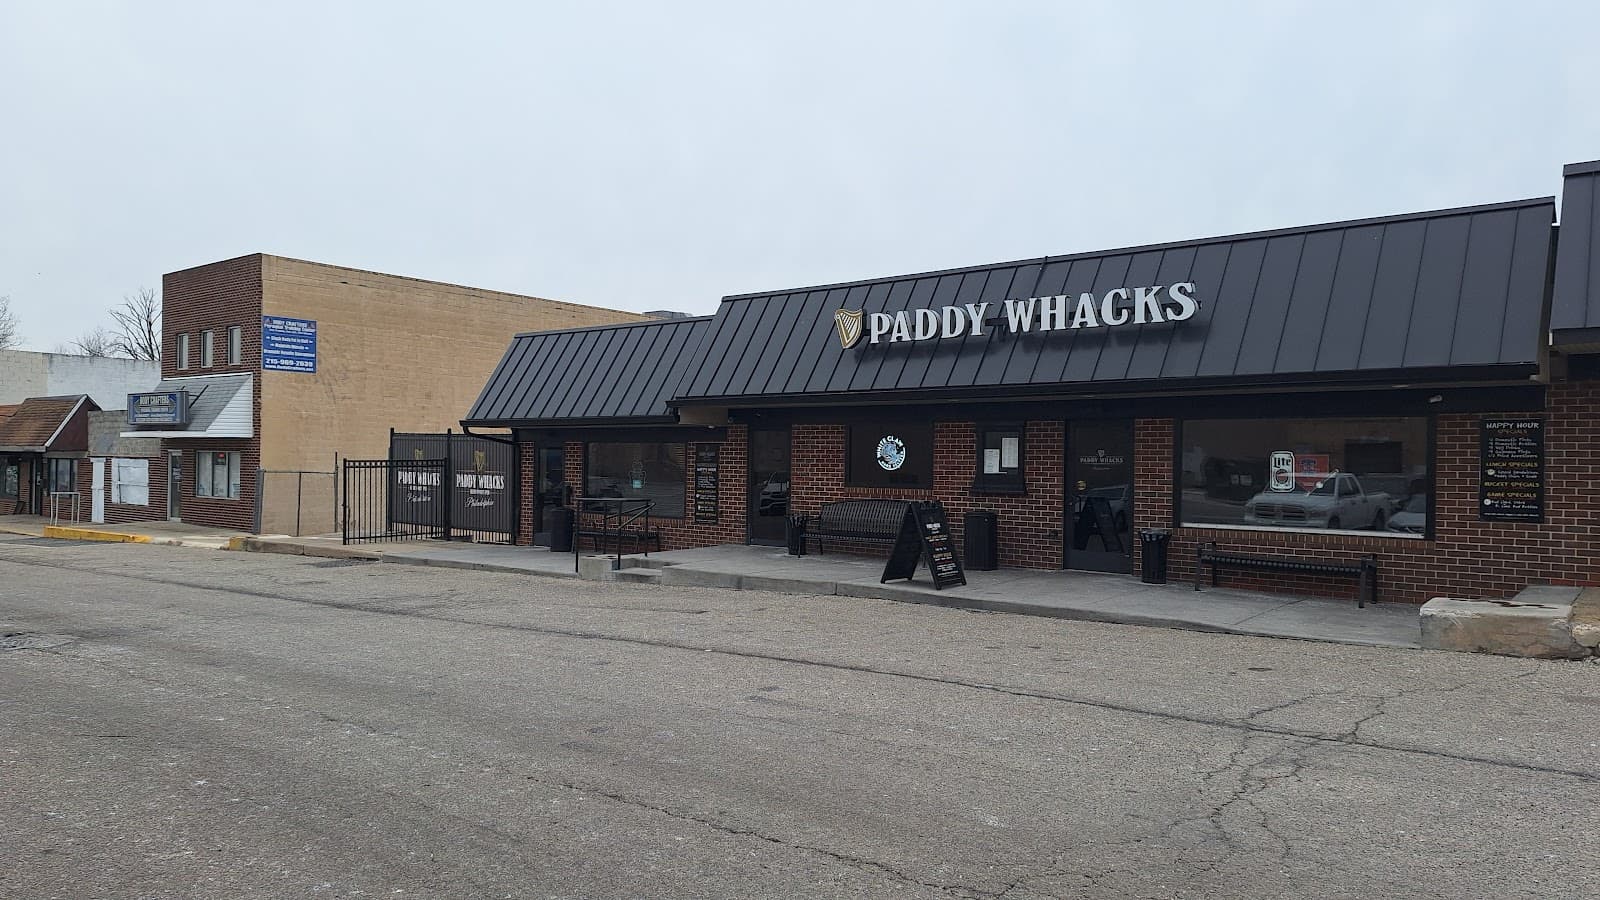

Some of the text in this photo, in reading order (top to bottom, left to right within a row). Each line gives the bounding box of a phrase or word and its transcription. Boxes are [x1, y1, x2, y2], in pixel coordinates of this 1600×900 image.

[870, 281, 1198, 344] PADDY WHACKS
[1272, 457, 1292, 469] Lite
[456, 474, 504, 490] PADDY WHACKS
